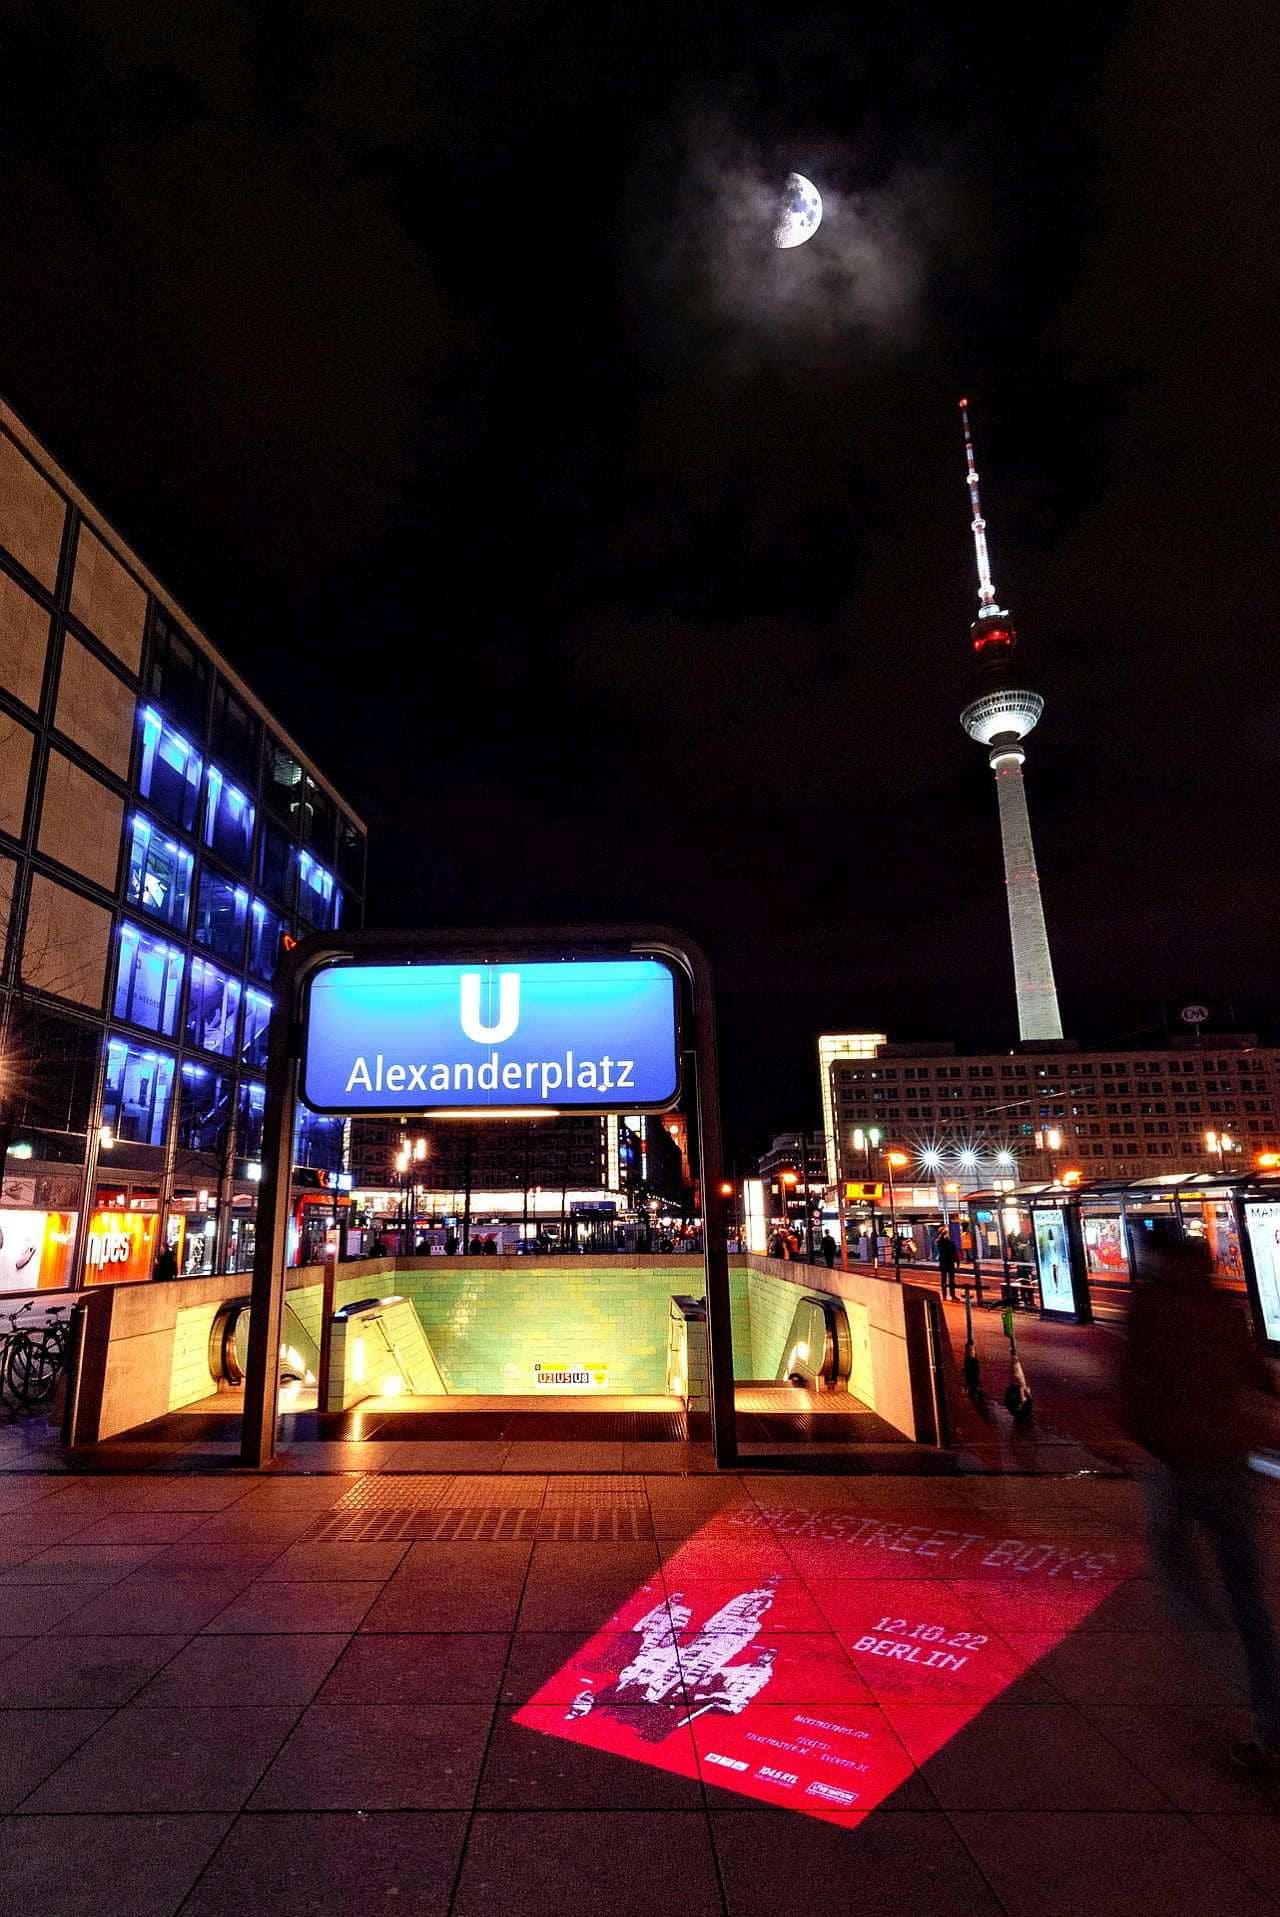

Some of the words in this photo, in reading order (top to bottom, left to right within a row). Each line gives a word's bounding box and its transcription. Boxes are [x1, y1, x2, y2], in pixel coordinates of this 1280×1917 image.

[460, 972, 521, 1044] U
[345, 1051, 636, 1098] Alexanderplatz
[539, 1373, 553, 1383] U2
[556, 1373, 571, 1383] U5
[573, 1373, 589, 1383] U8
[982, 1538, 1116, 1582] BOYS
[872, 1615, 989, 1651] 12.10.22
[852, 1635, 967, 1672] BERLIN
